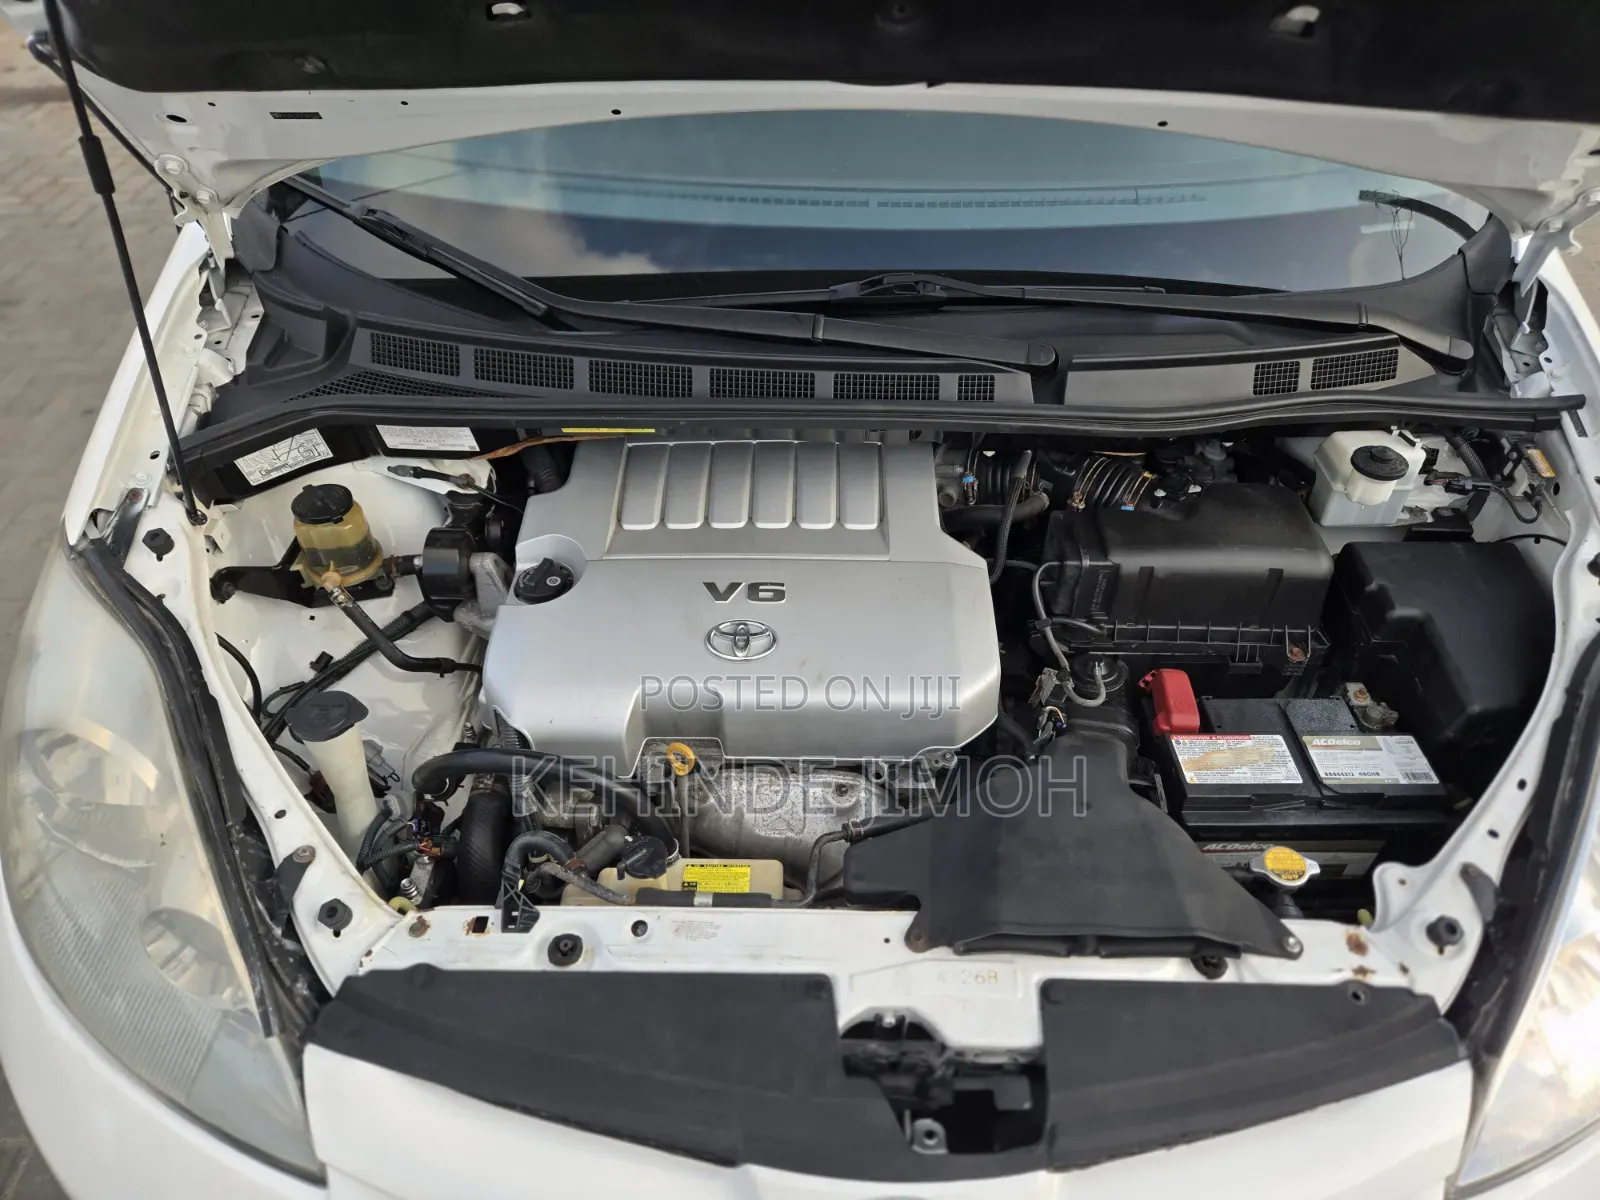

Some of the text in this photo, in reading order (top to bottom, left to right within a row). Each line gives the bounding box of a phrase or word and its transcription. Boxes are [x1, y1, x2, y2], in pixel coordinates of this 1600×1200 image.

[702, 582, 786, 603] V6
[1311, 738, 1361, 746] ACDelco
[1202, 842, 1274, 850] ACDelco
